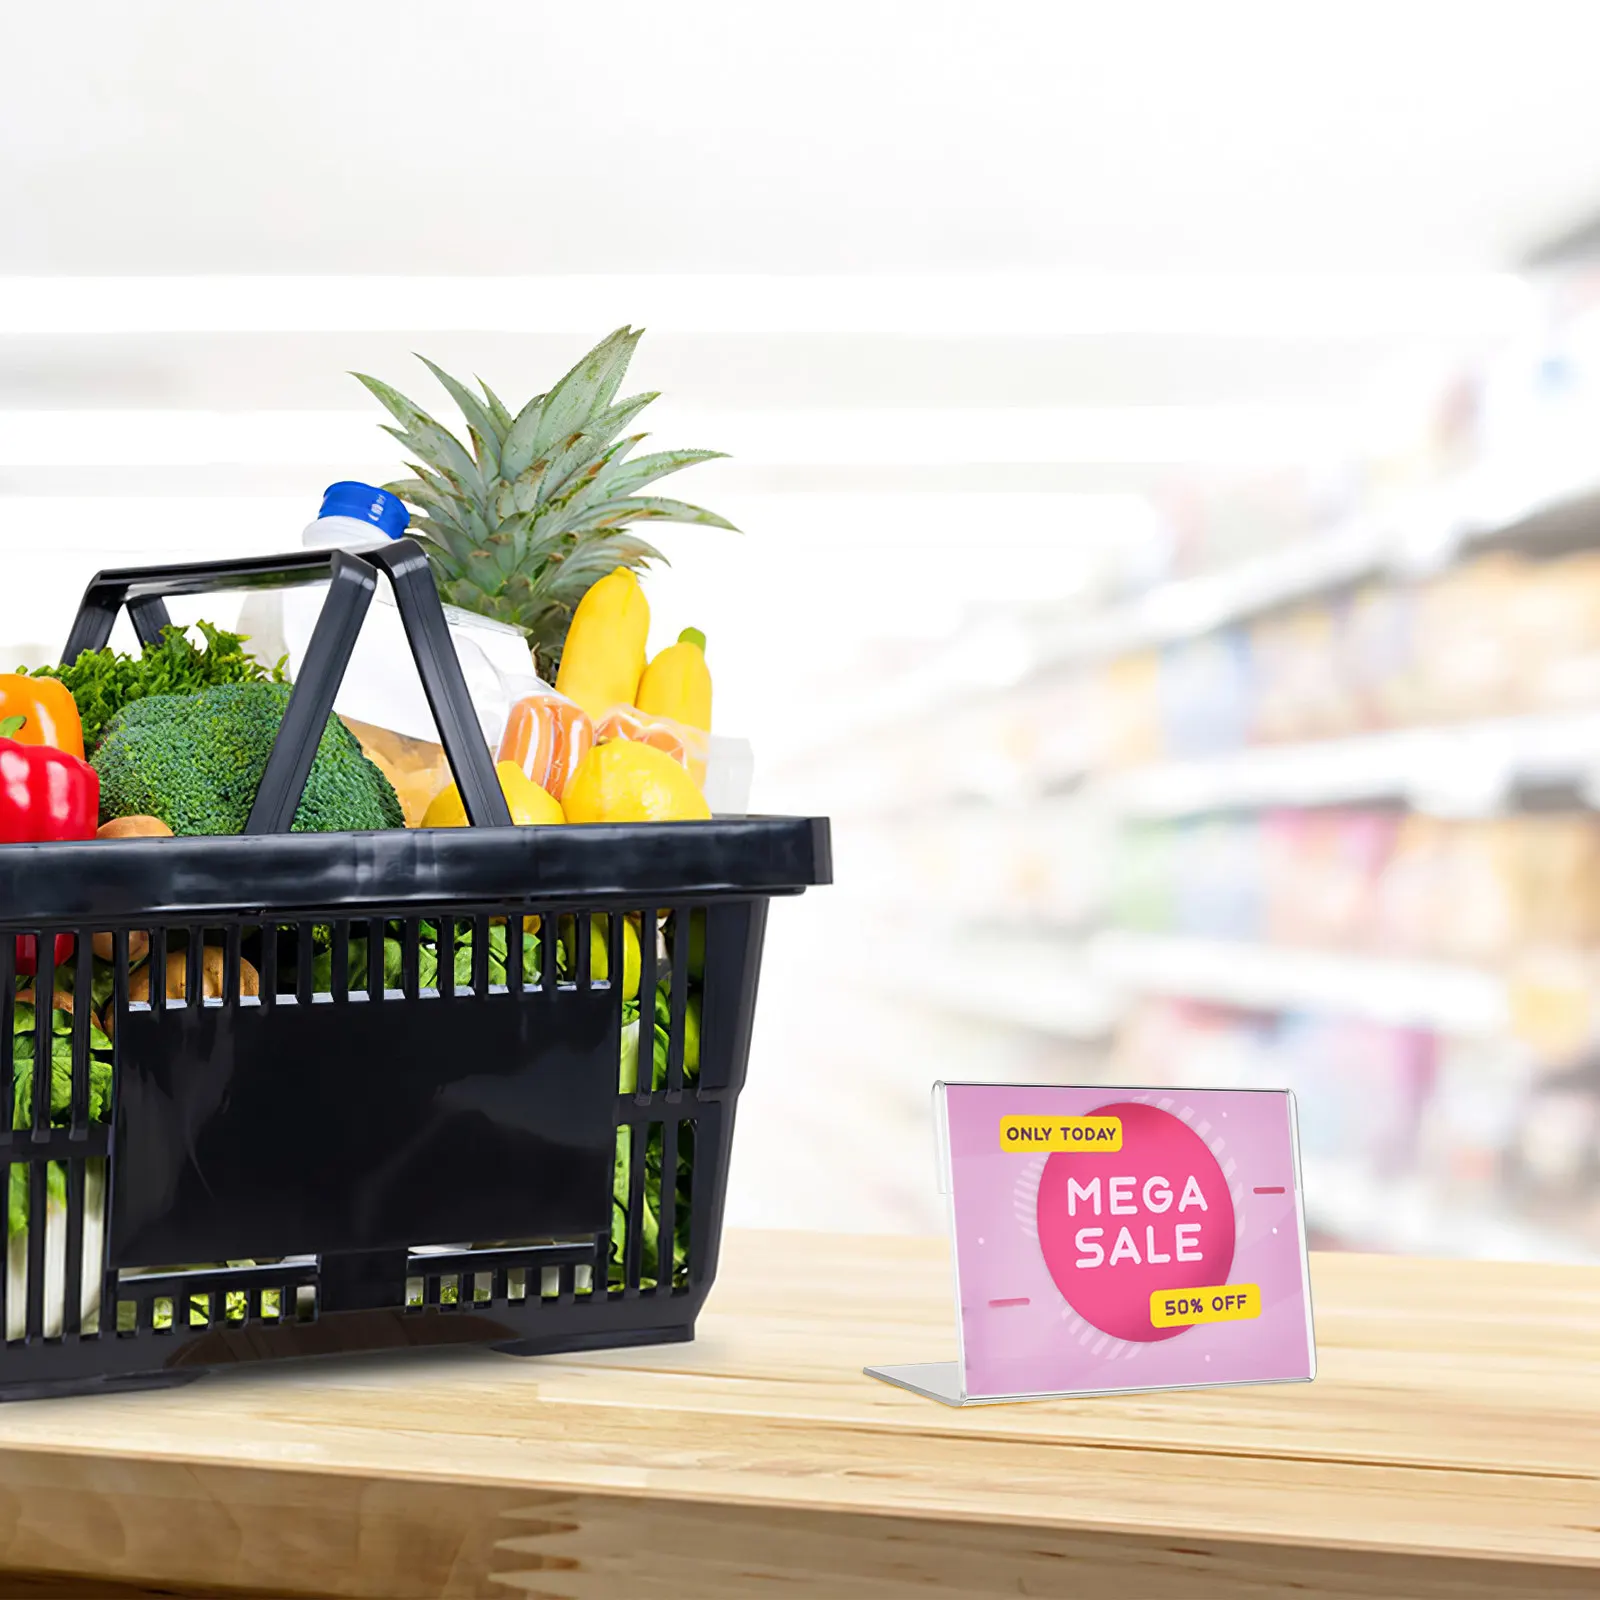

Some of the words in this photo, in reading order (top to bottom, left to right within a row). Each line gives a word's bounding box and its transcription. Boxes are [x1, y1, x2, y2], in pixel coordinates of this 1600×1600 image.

[1006, 1127, 1052, 1141] ONLY
[1060, 1127, 1117, 1141] TODAY
[1067, 1175, 1208, 1216] MEGA
[1075, 1223, 1203, 1268] SALE
[1165, 1297, 1204, 1316] 50%
[1212, 1294, 1247, 1311] OFF
